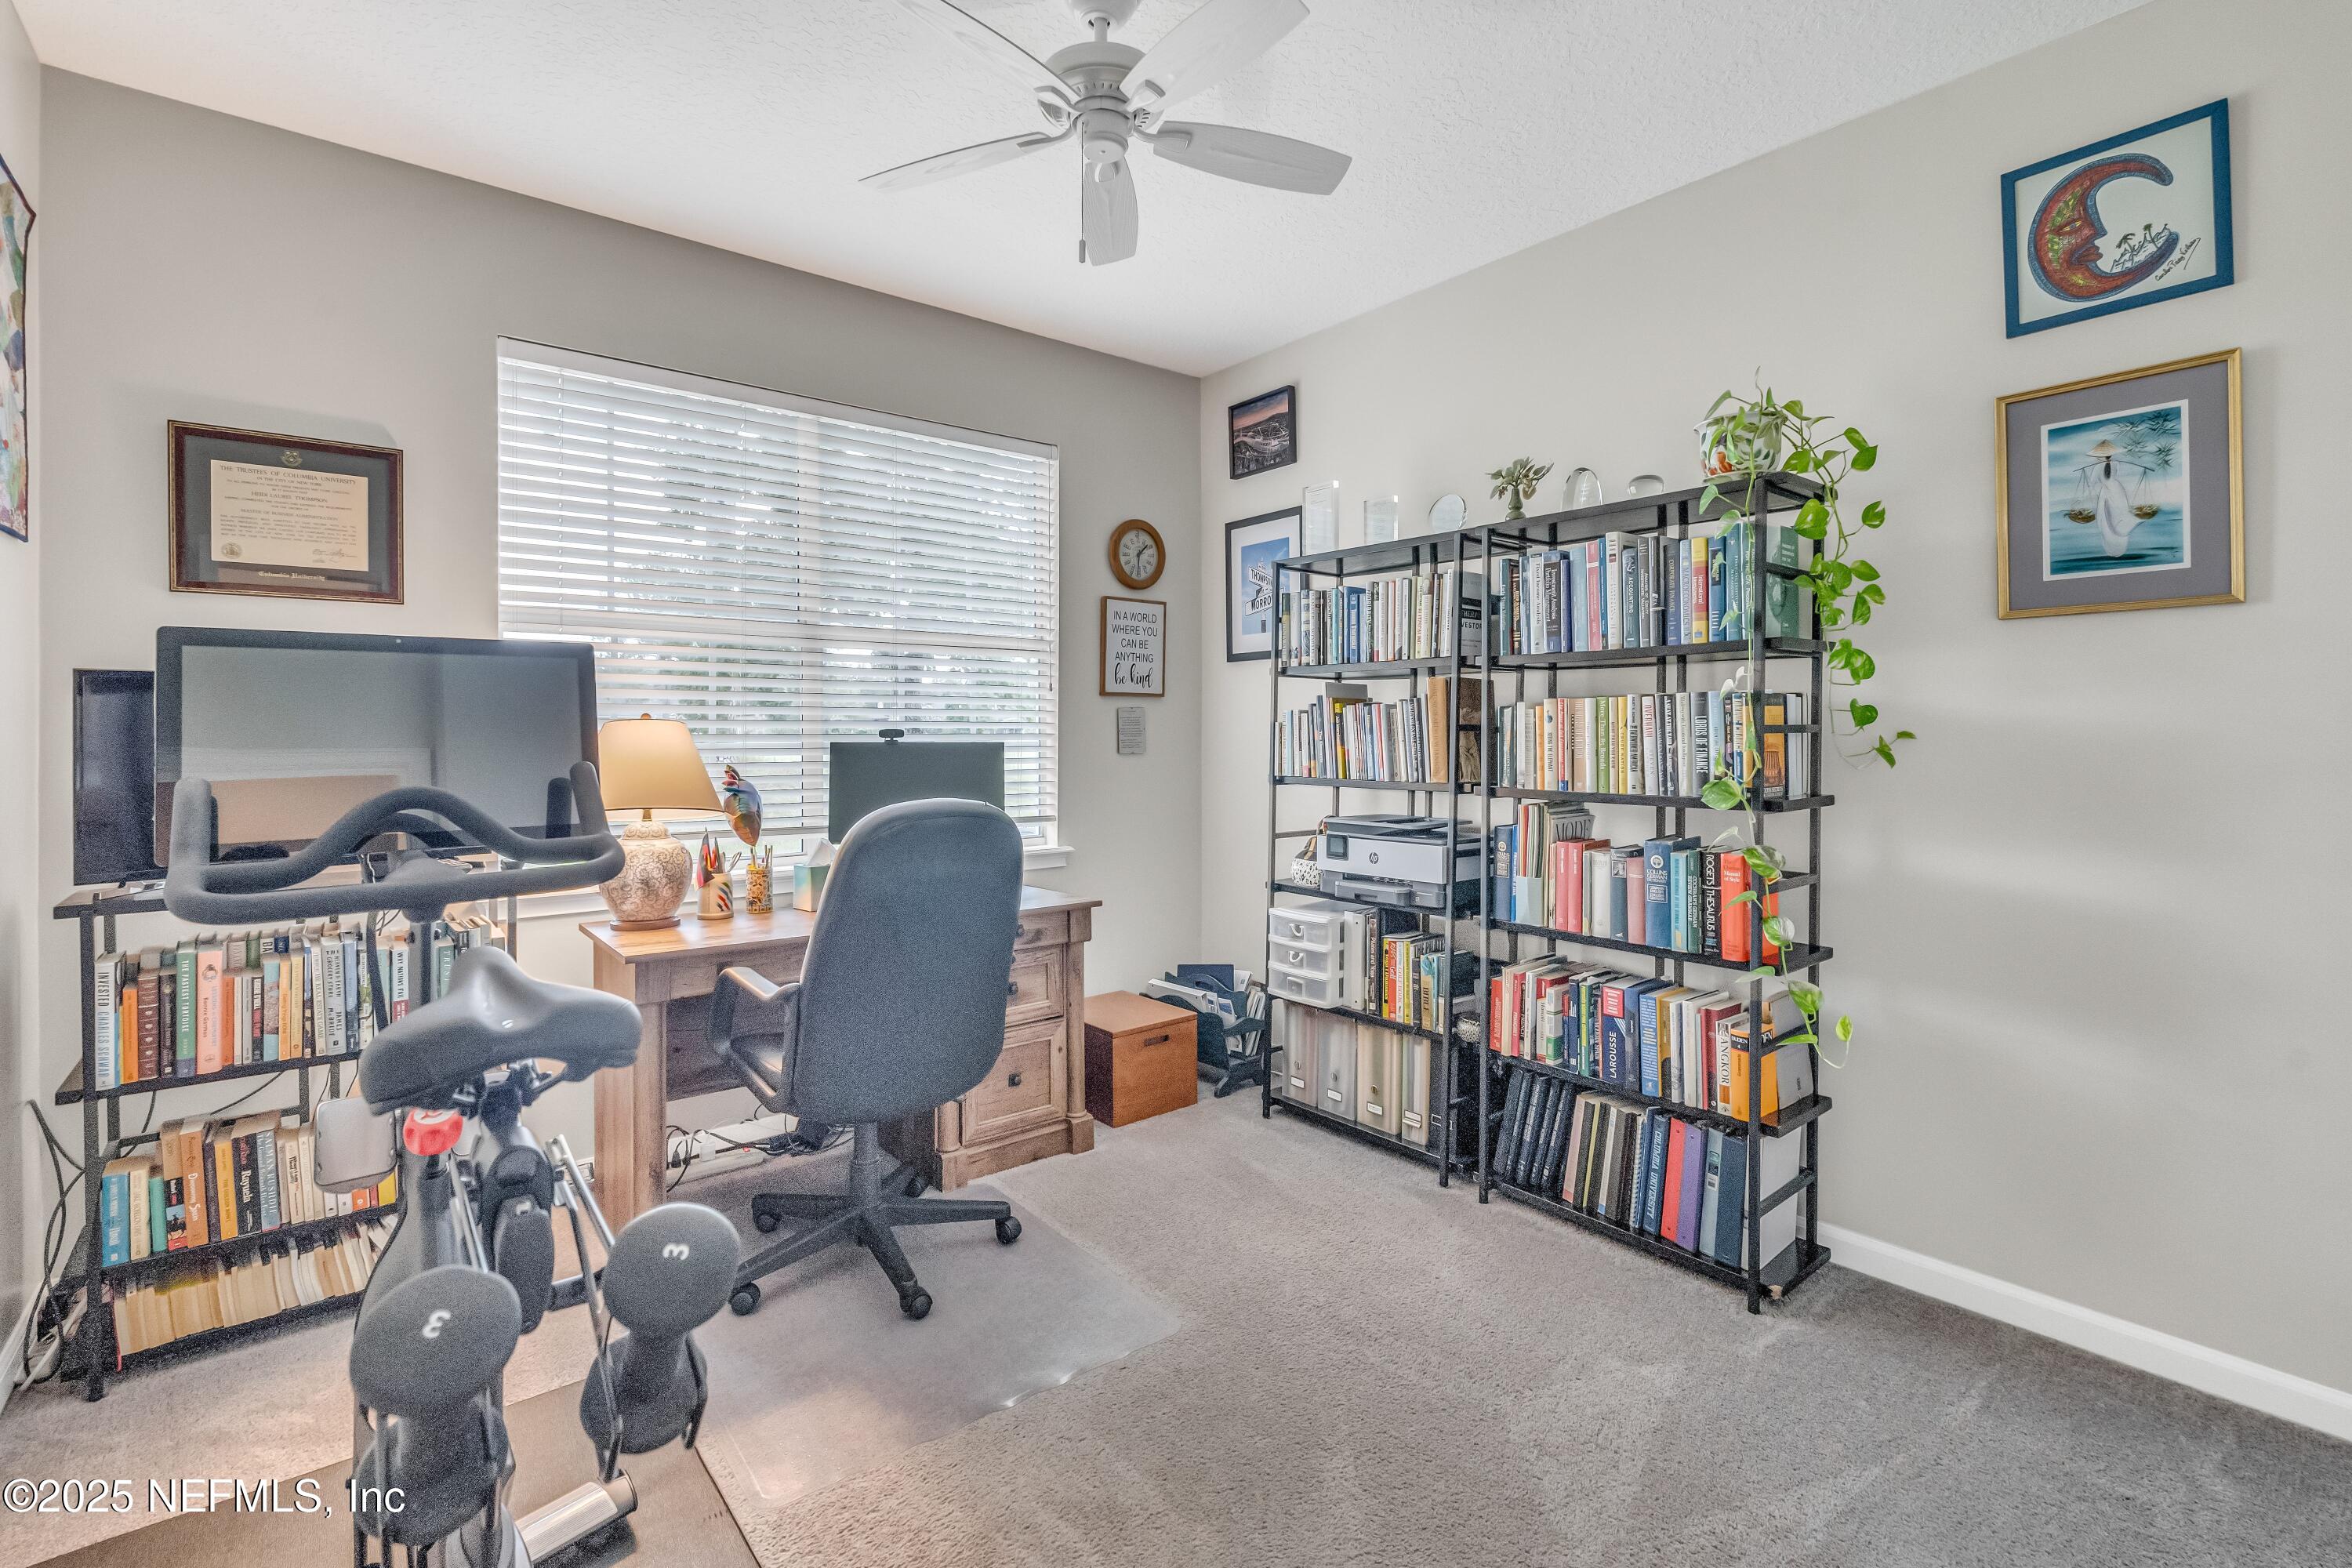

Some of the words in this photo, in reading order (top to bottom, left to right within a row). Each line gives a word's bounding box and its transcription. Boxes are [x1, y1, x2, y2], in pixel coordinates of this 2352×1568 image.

[235, 466, 267, 475] TRUSTEES
[283, 472, 318, 481] COLUMBIA
[321, 477, 356, 485] UNIVERSITY
[291, 572, 325, 581] University
[1250, 568, 1272, 586] THOMPSO
[1251, 595, 1272, 612] MORRO
[1682, 568, 1690, 626] MACROECONOMICS
[1113, 611, 1121, 620] IN
[1123, 612, 1128, 621] A
[1130, 612, 1157, 623] WORLD
[1112, 624, 1140, 635] WHERE
[1142, 626, 1158, 637] YOU
[1120, 638, 1137, 649] CAN
[1138, 640, 1149, 649] BE
[1115, 652, 1154, 663] ANYTHING
[1114, 662, 1127, 685] be
[1130, 663, 1153, 688] kind
[1645, 705, 1653, 738] OVERHAUL
[1694, 715, 1708, 735] LORDS
[1696, 737, 1708, 746] OF
[1630, 753, 1639, 773] AMERICAN
[1696, 747, 1708, 774] FINANCE
[1370, 852, 1378, 864] hp
[1706, 889, 1715, 931] THESAURUS
[97, 972, 109, 1007] INVESTED
[98, 1011, 110, 1045] CHARLES
[1731, 1035, 1748, 1044] DUDEN
[98, 1047, 110, 1077] SCHWAB
[1720, 1037, 1730, 1083] ANGKOR
[264, 1131, 274, 1170] SALMAN
[1651, 1130, 1661, 1170] COLUMBIA
[240, 1169, 253, 1203] Rayuela
[267, 1173, 278, 1214] RUSHDIE
[1646, 1171, 1658, 1221] UNIVERSITY
[190, 1203, 201, 1221] Spain
[662, 1243, 690, 1260] 3
[422, 1309, 451, 1338] 3
